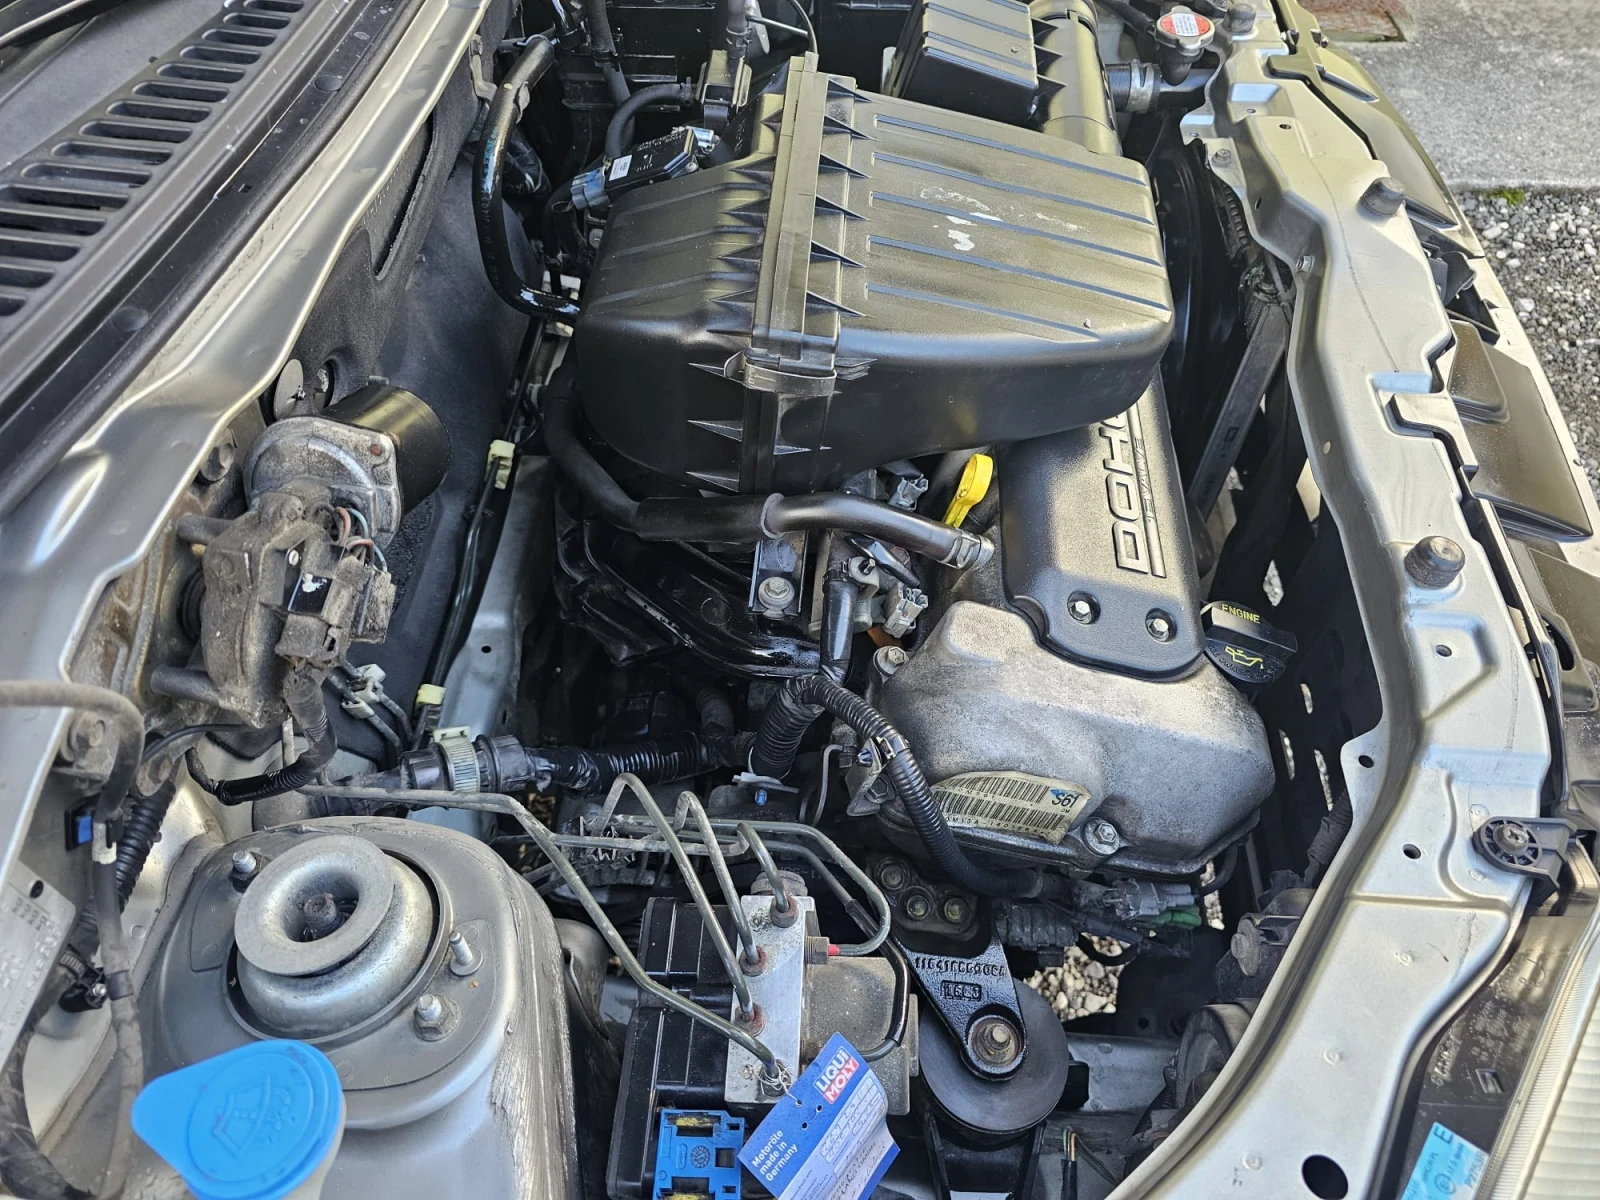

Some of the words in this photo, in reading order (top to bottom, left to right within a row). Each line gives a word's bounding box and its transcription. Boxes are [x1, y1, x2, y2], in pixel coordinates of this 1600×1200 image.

[1221, 603, 1260, 624] ENGINE
[1051, 791, 1081, 808] S61
[816, 1050, 851, 1091] LIQUI
[826, 1059, 857, 1100] MOLY
[752, 1130, 783, 1167] Motoröle
[759, 1151, 780, 1174] made
[778, 1141, 788, 1151] in
[766, 1143, 798, 1181] Germany
